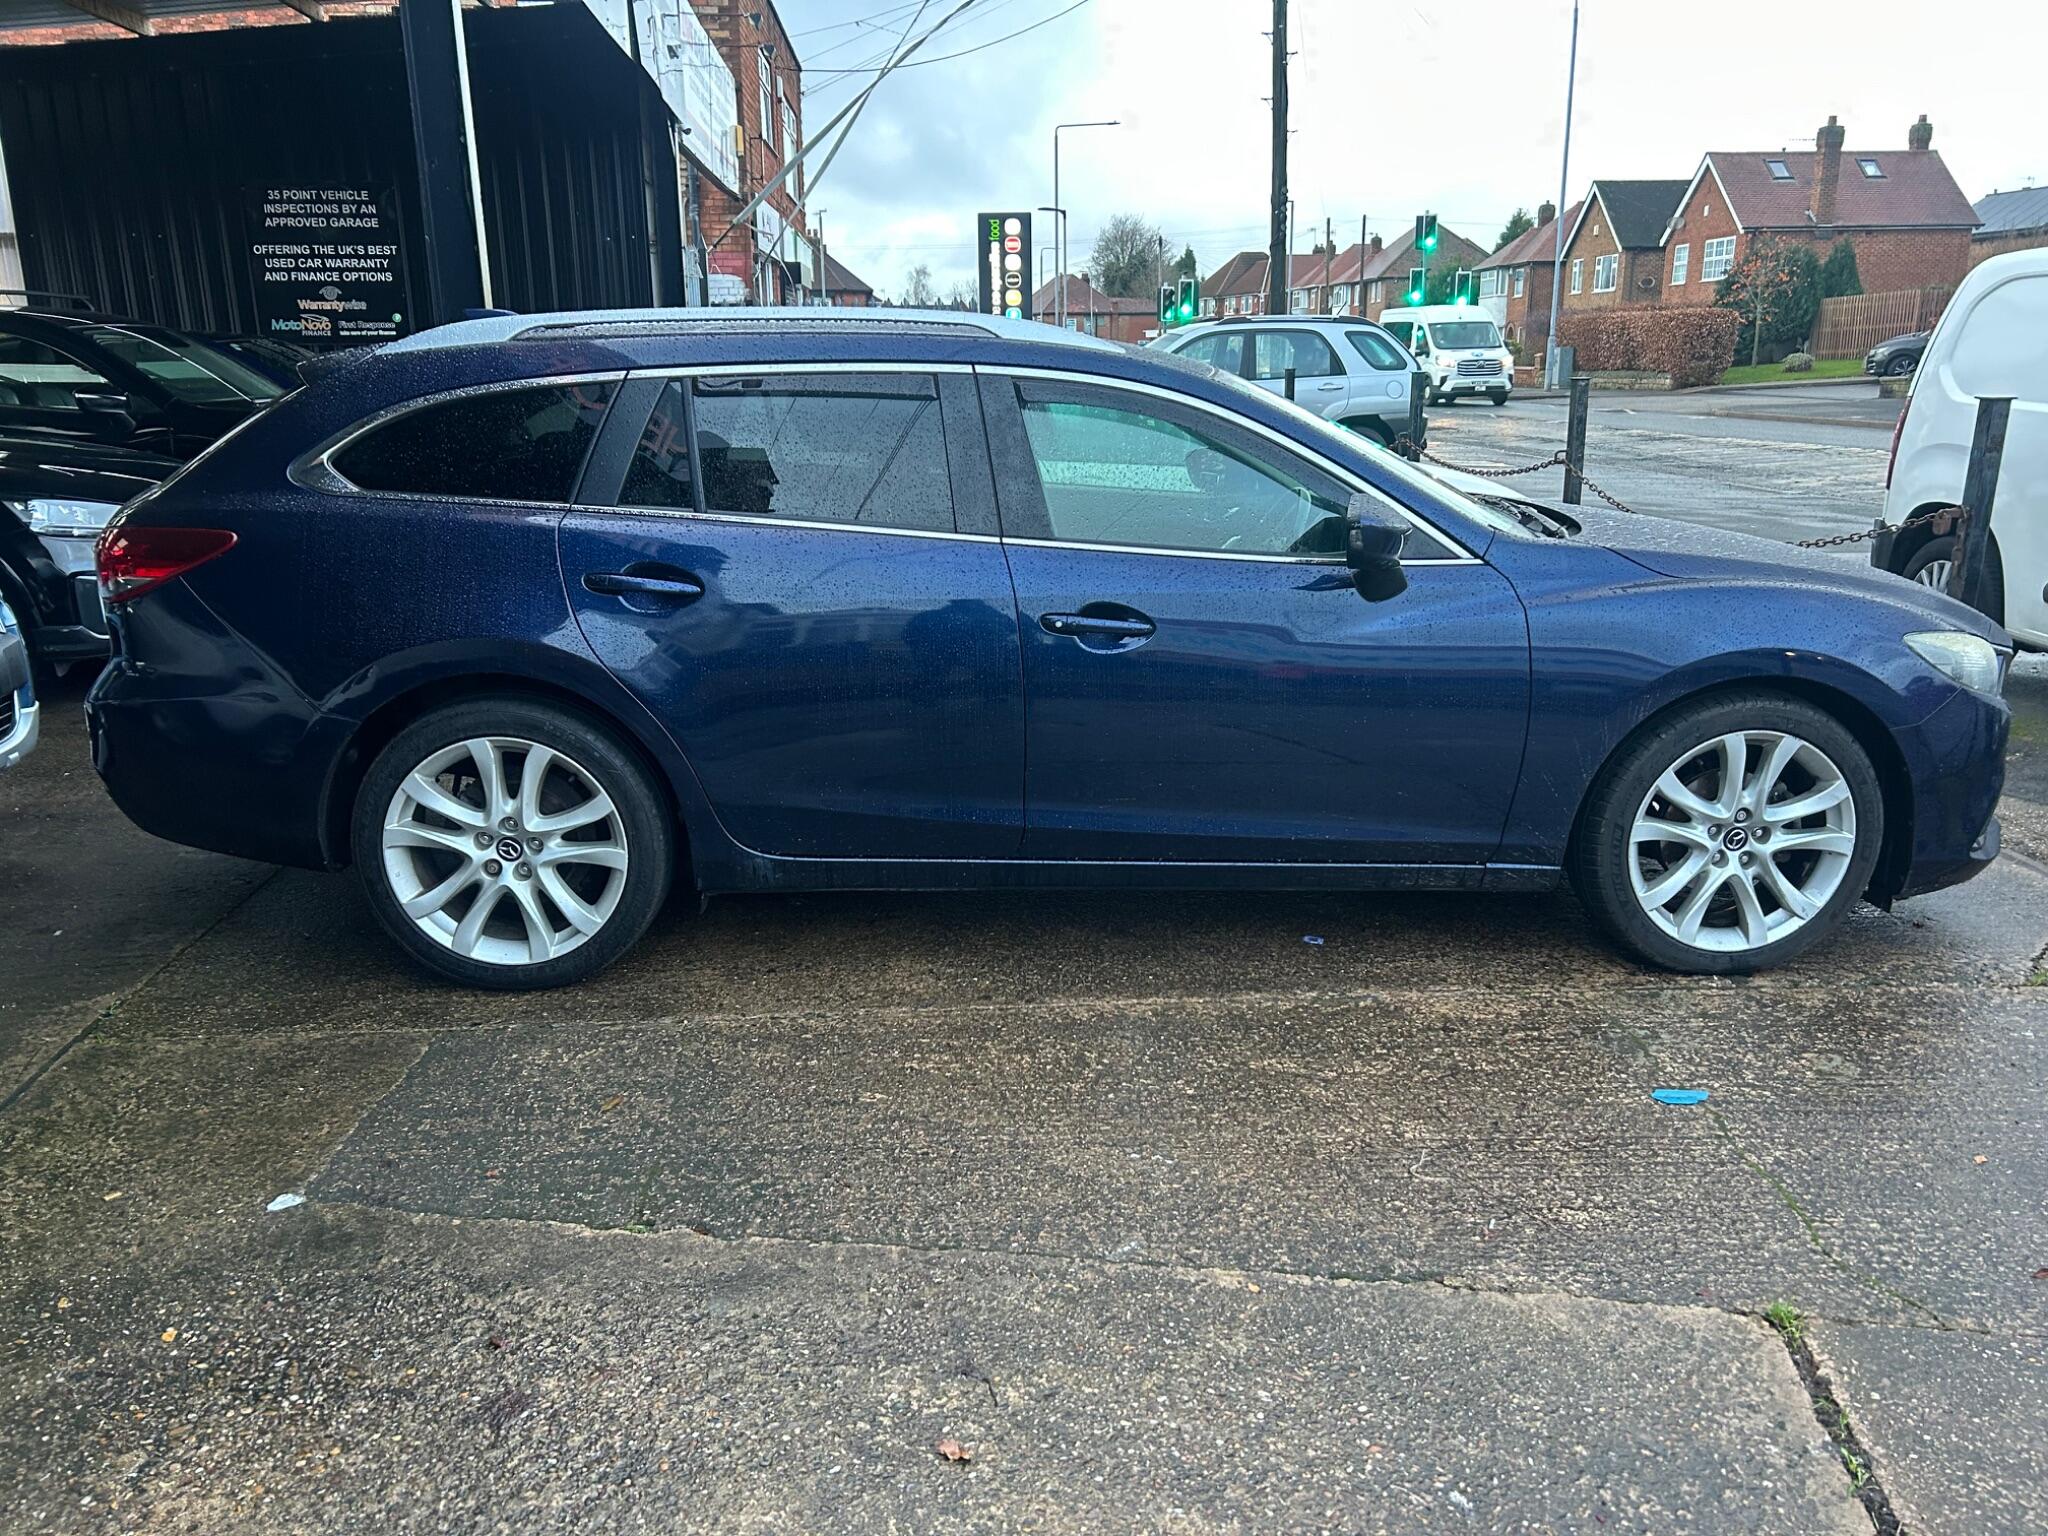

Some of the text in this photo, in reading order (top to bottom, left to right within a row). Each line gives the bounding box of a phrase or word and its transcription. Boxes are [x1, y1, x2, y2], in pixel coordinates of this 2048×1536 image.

[267, 190, 369, 200] 35 POINT VEHICLE
[263, 204, 377, 214] INSPECTIONS BY AN
[264, 217, 380, 228] APPROVED GARAGE
[988, 219, 1000, 241] food
[253, 245, 398, 255] OFFERING THE UK'S BEST
[264, 258, 389, 268] USED CAR WARRANTY
[264, 272, 393, 282] AND FINANCE OPTIONS
[271, 318, 332, 330] MotoNovo
